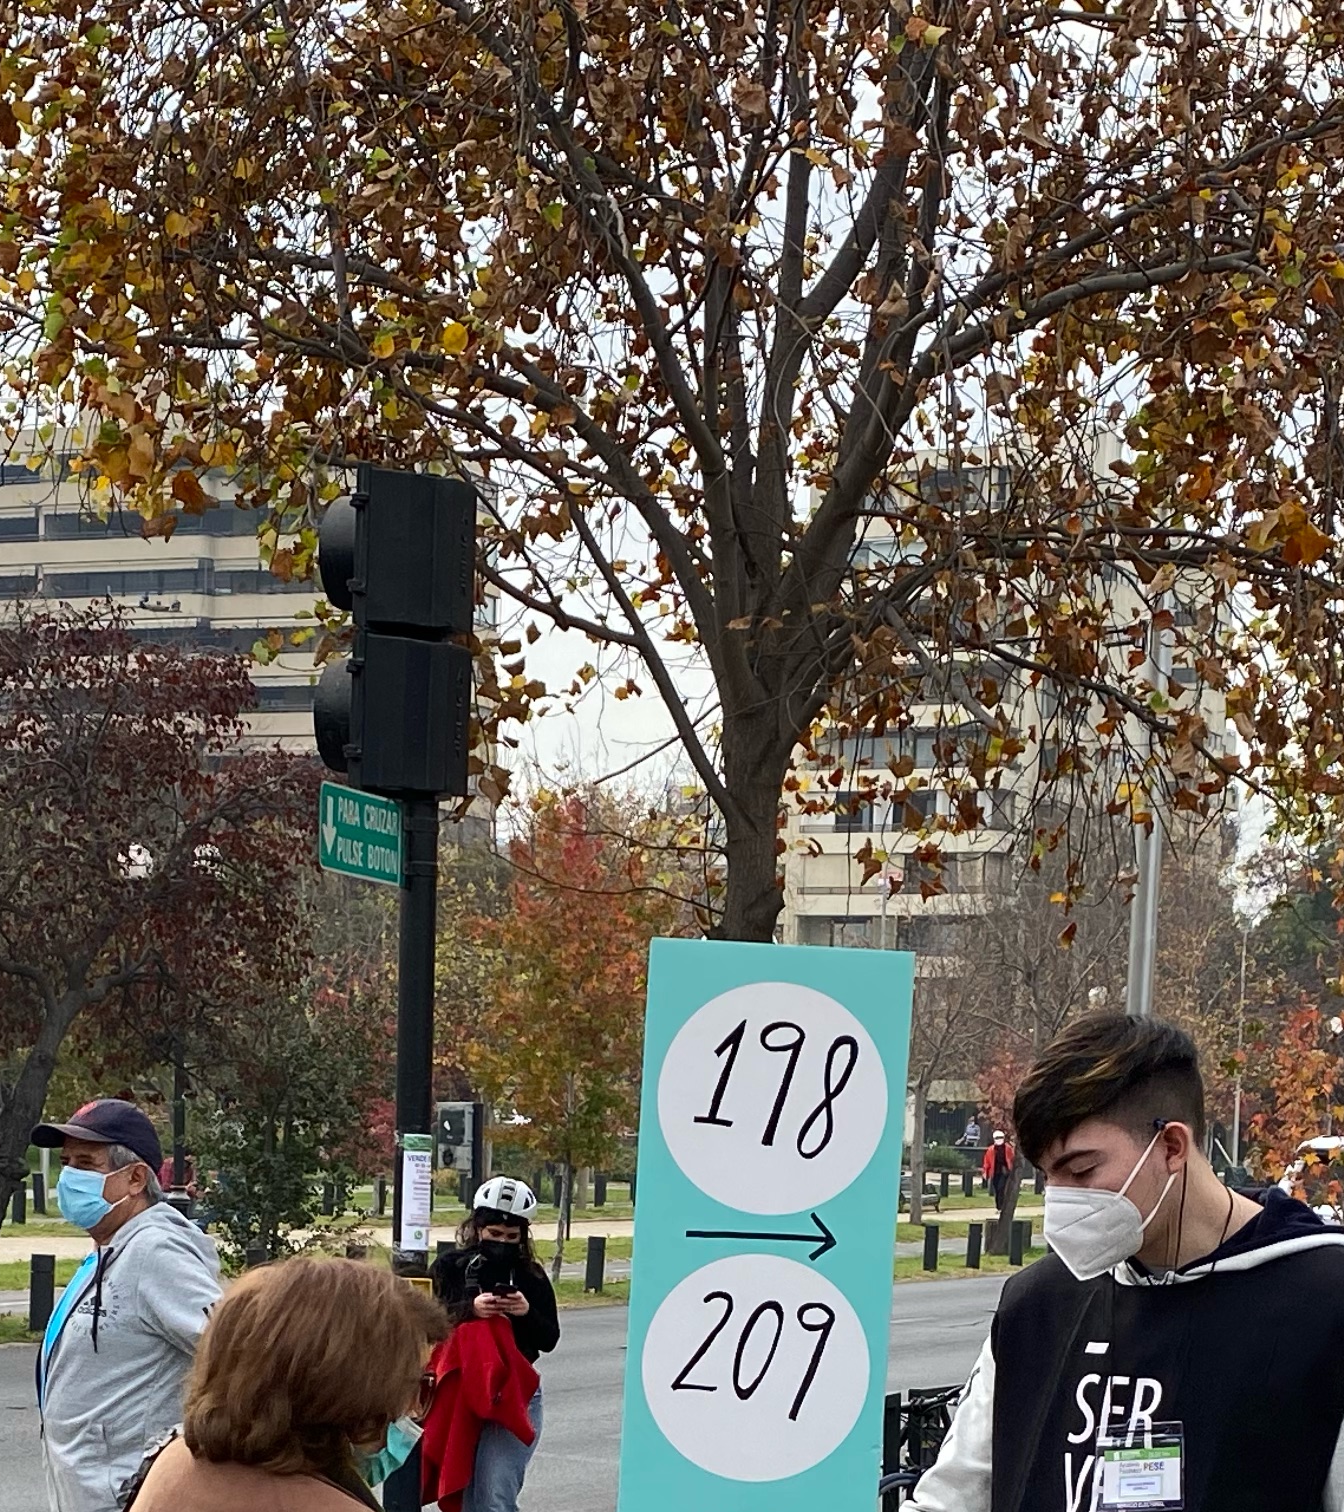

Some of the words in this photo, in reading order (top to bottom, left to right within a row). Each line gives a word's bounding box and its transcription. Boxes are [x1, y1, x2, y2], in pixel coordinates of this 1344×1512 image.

[338, 796, 360, 827] PARA
[364, 804, 398, 836] CRUZAR
[337, 836, 363, 868] PULSE
[367, 844, 398, 875] BOTON
[694, 1020, 858, 1159] 198
[671, 1291, 835, 1421] 209
[1067, 1373, 1163, 1449] SER
